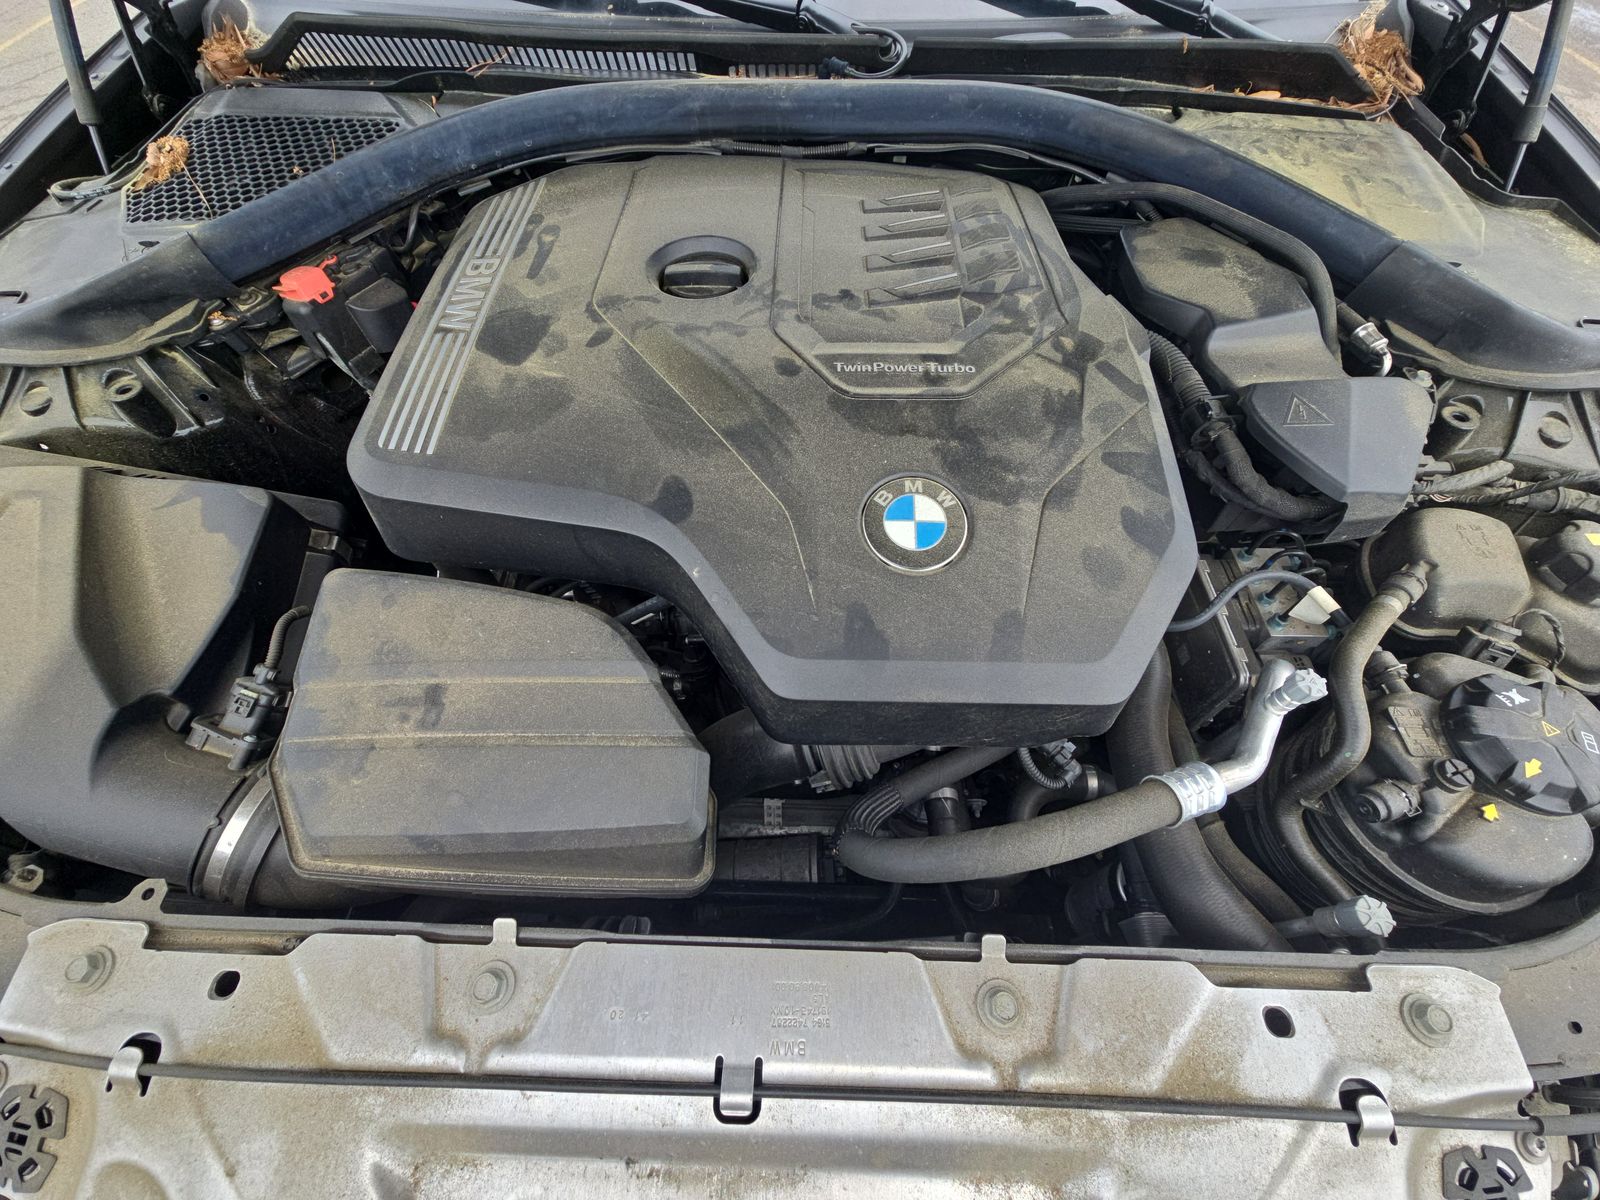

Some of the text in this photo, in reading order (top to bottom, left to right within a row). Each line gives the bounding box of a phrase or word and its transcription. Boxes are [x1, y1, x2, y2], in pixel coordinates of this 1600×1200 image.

[438, 258, 501, 330] BMW
[926, 362, 976, 373] Turbo
[873, 480, 957, 508] BMW
[769, 1040, 806, 1056] BMW
